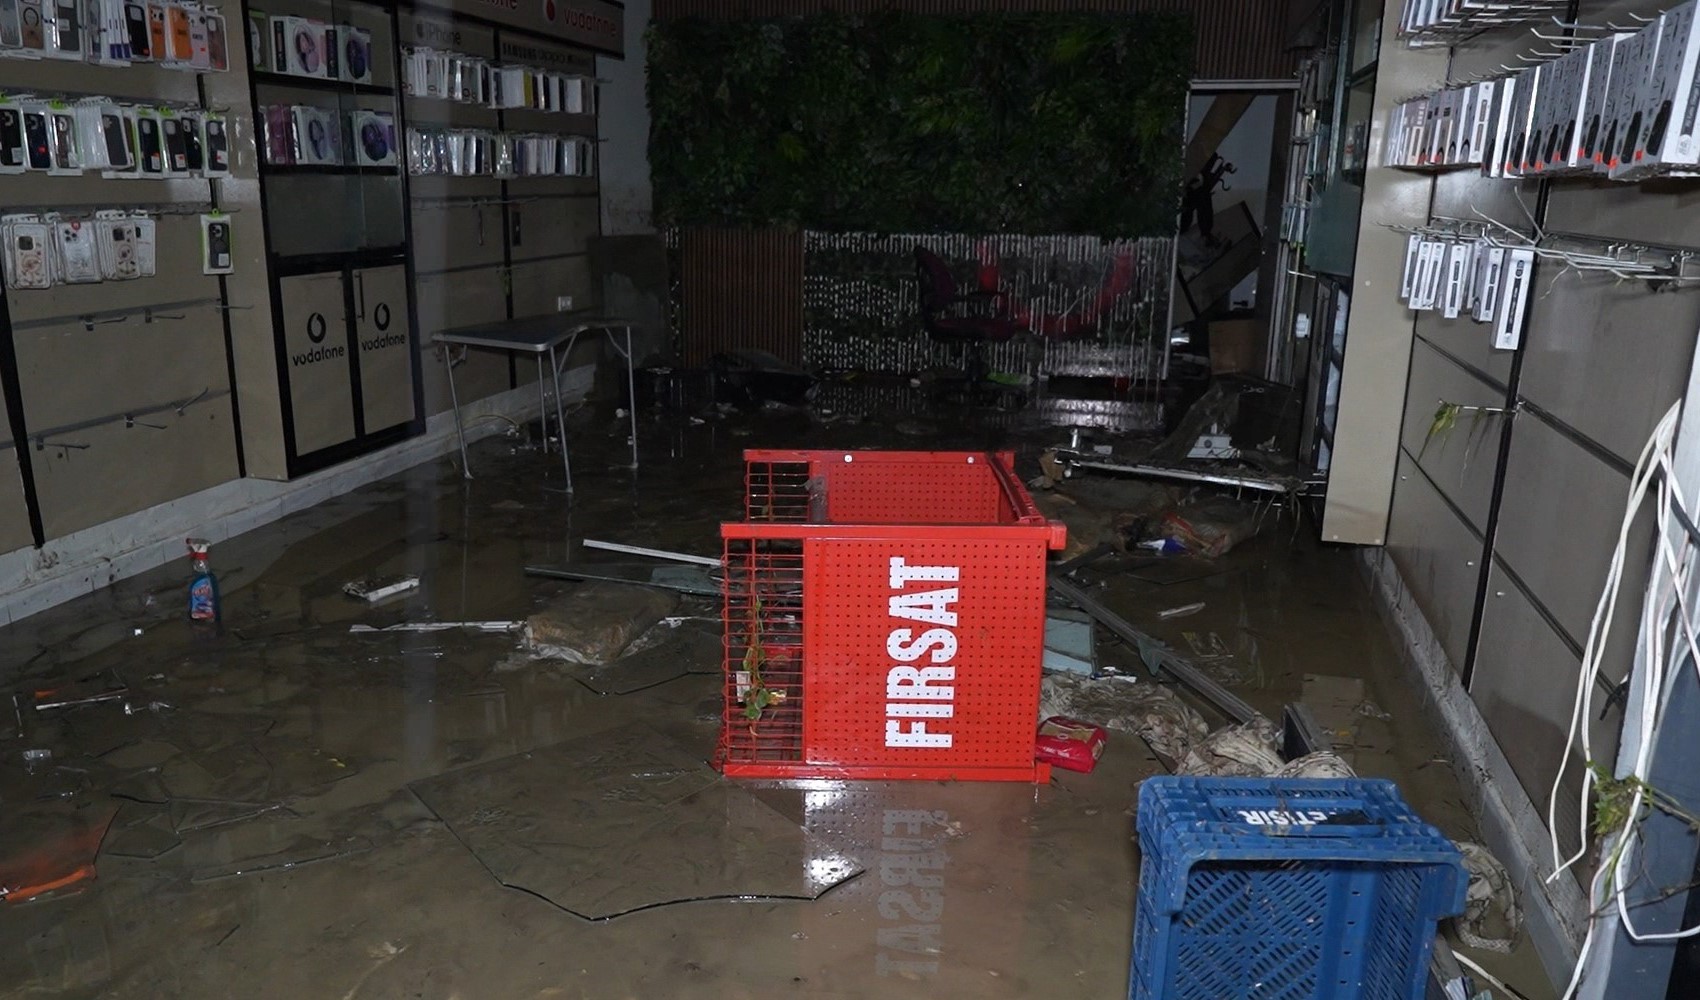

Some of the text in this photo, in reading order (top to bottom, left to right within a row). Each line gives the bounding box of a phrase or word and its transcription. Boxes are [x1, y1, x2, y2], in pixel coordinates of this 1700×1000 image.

[361, 334, 405, 351] vodafone
[292, 346, 344, 367] vodafone
[885, 556, 960, 748] FIRSAT
